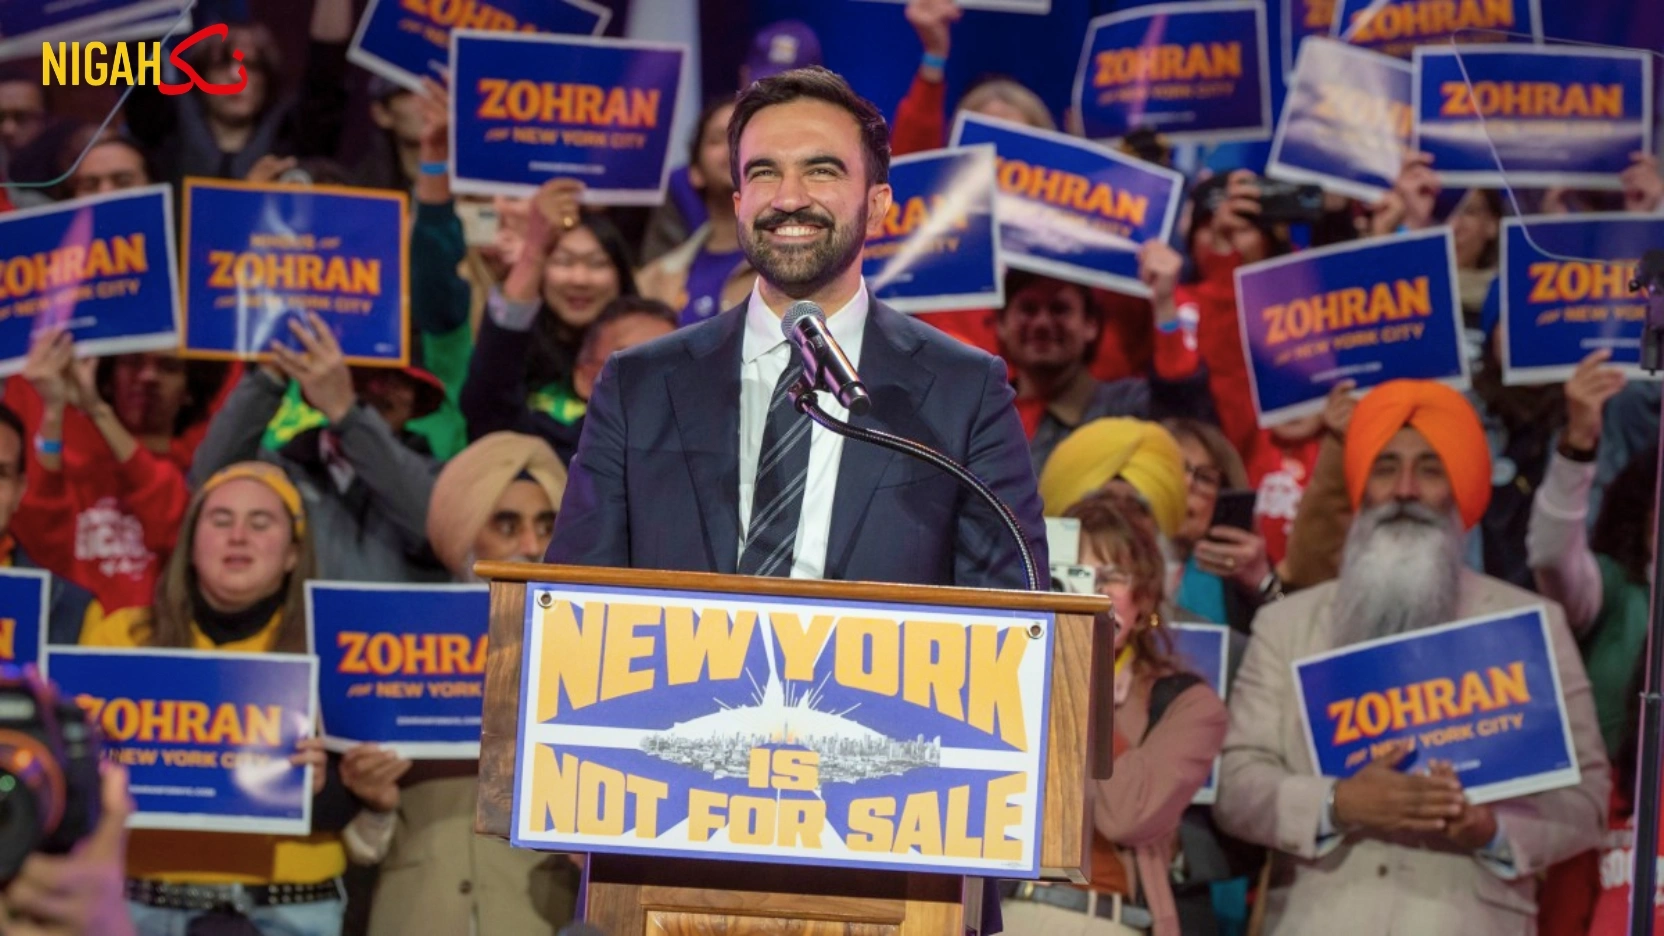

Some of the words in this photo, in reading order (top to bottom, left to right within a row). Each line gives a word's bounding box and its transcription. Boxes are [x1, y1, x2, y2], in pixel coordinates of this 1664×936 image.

[1094, 41, 1242, 88] ZOHRAN
[478, 78, 660, 128] ZOHRAN
[1440, 81, 1624, 118] ZOHRAN
[208, 250, 381, 296] ZOHRAN
[1262, 275, 1432, 345] ZOHRAN
[376, 681, 423, 698] NEW
[536, 600, 758, 723] NEW
[768, 611, 1029, 753] YORK
[1328, 661, 1531, 746] ZOHRAN
[1419, 725, 1476, 749] YORK
[1477, 712, 1524, 738] CITY
[161, 749, 216, 768] YORK
[747, 746, 820, 791] IS
[529, 741, 669, 839] NOT
[687, 787, 826, 849] FOR
[846, 771, 1028, 860] SALE
